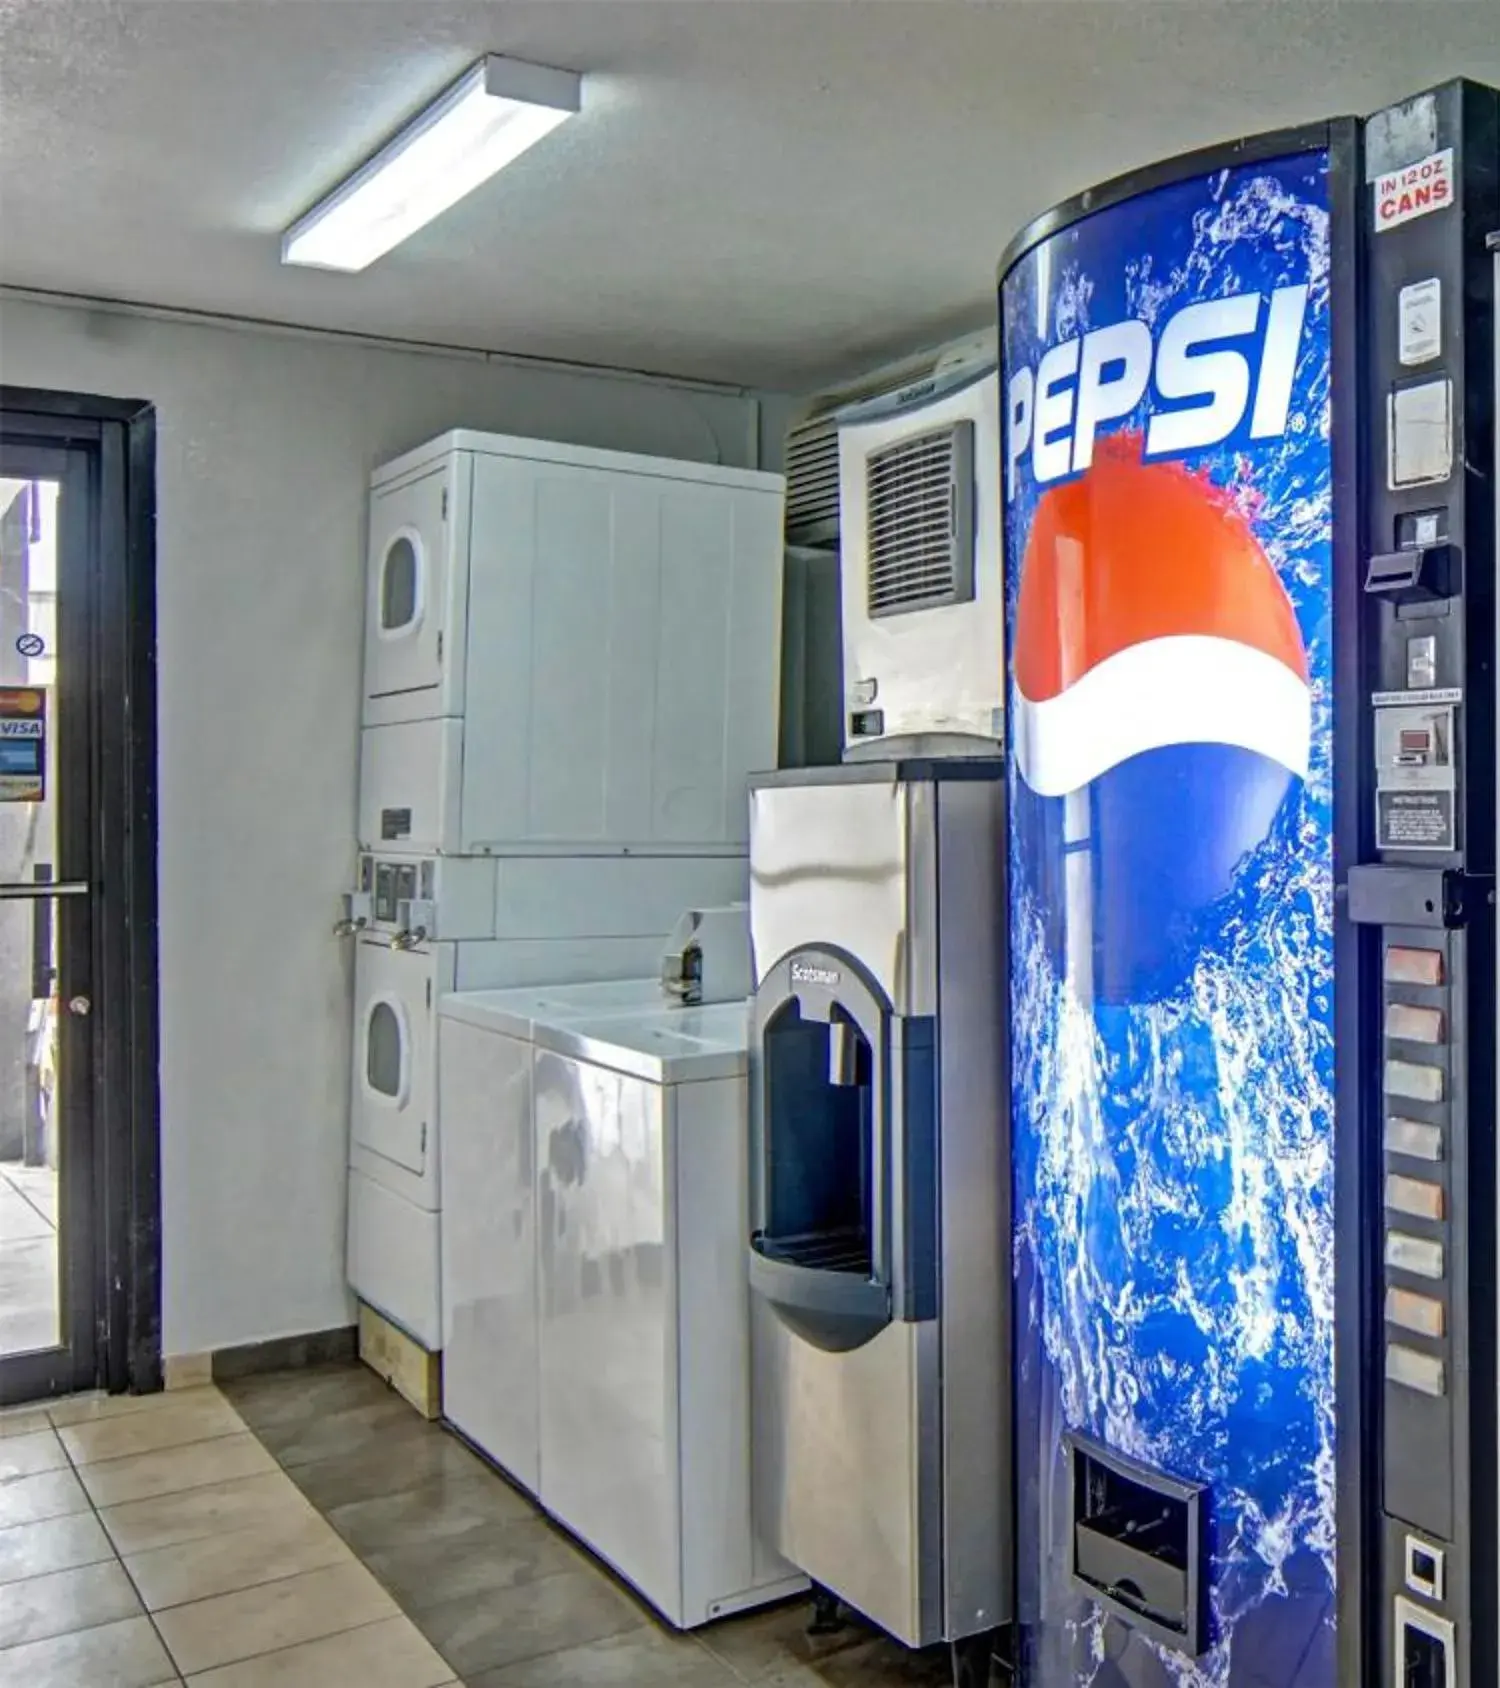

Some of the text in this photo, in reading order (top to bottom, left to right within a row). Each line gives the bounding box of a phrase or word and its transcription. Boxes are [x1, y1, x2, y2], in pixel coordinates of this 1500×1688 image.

[1381, 159, 1445, 197] IN 12 OZ
[1379, 179, 1449, 221] CANS
[1007, 283, 1310, 504] PEPSI
[1, 721, 40, 735] VISA
